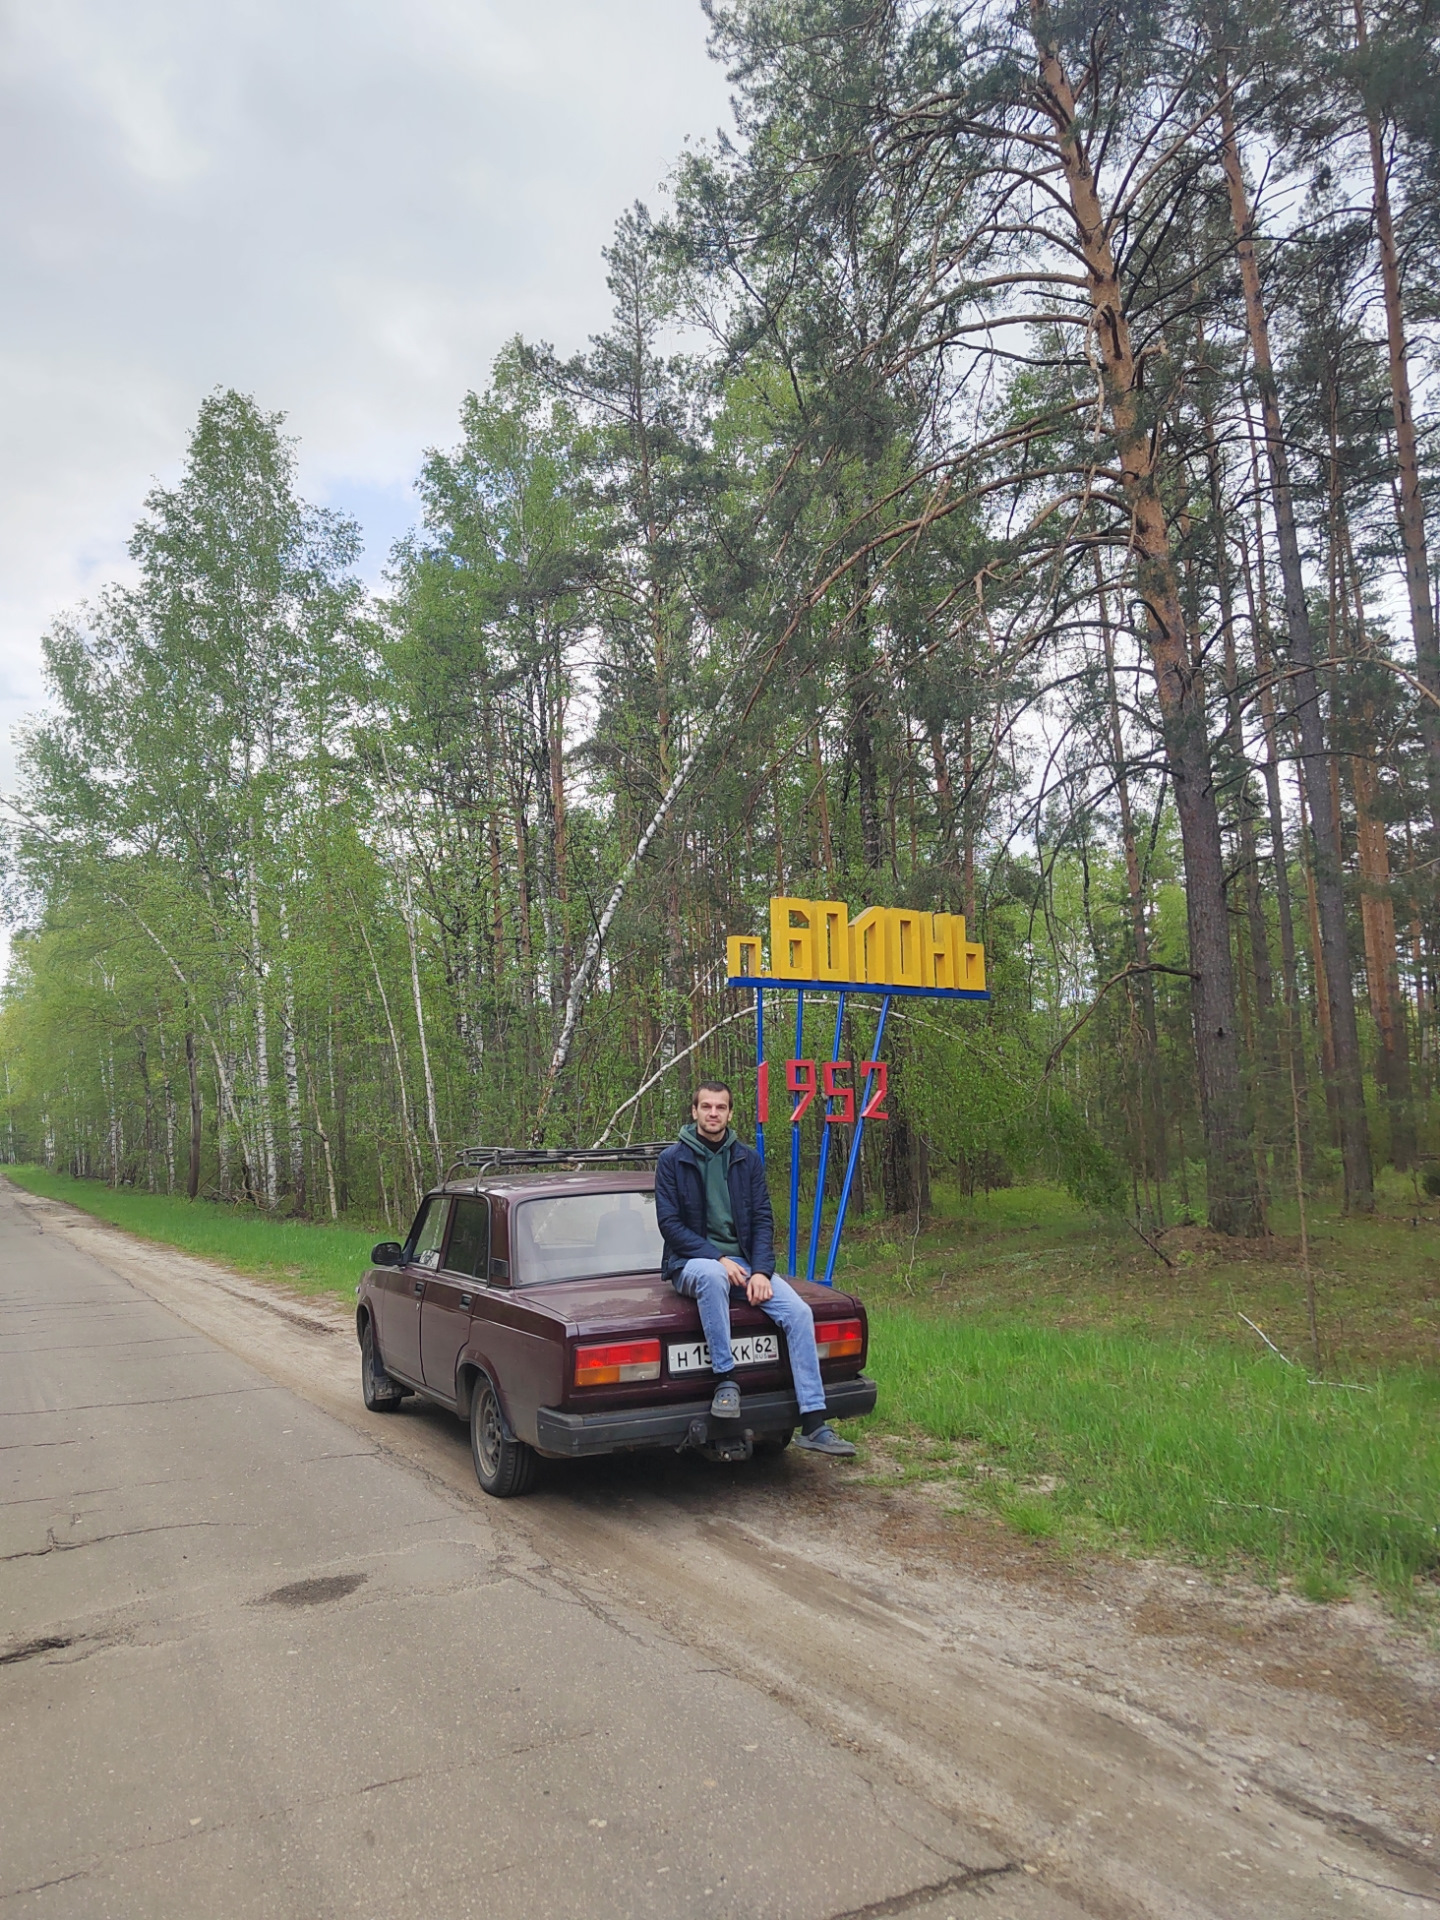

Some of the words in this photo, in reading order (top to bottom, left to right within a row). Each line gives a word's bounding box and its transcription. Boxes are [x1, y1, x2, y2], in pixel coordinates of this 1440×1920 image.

[770, 897, 985, 991] БОЛОНЬ
[757, 1059, 889, 1123] 1952
[754, 1337, 772, 1353] 62
